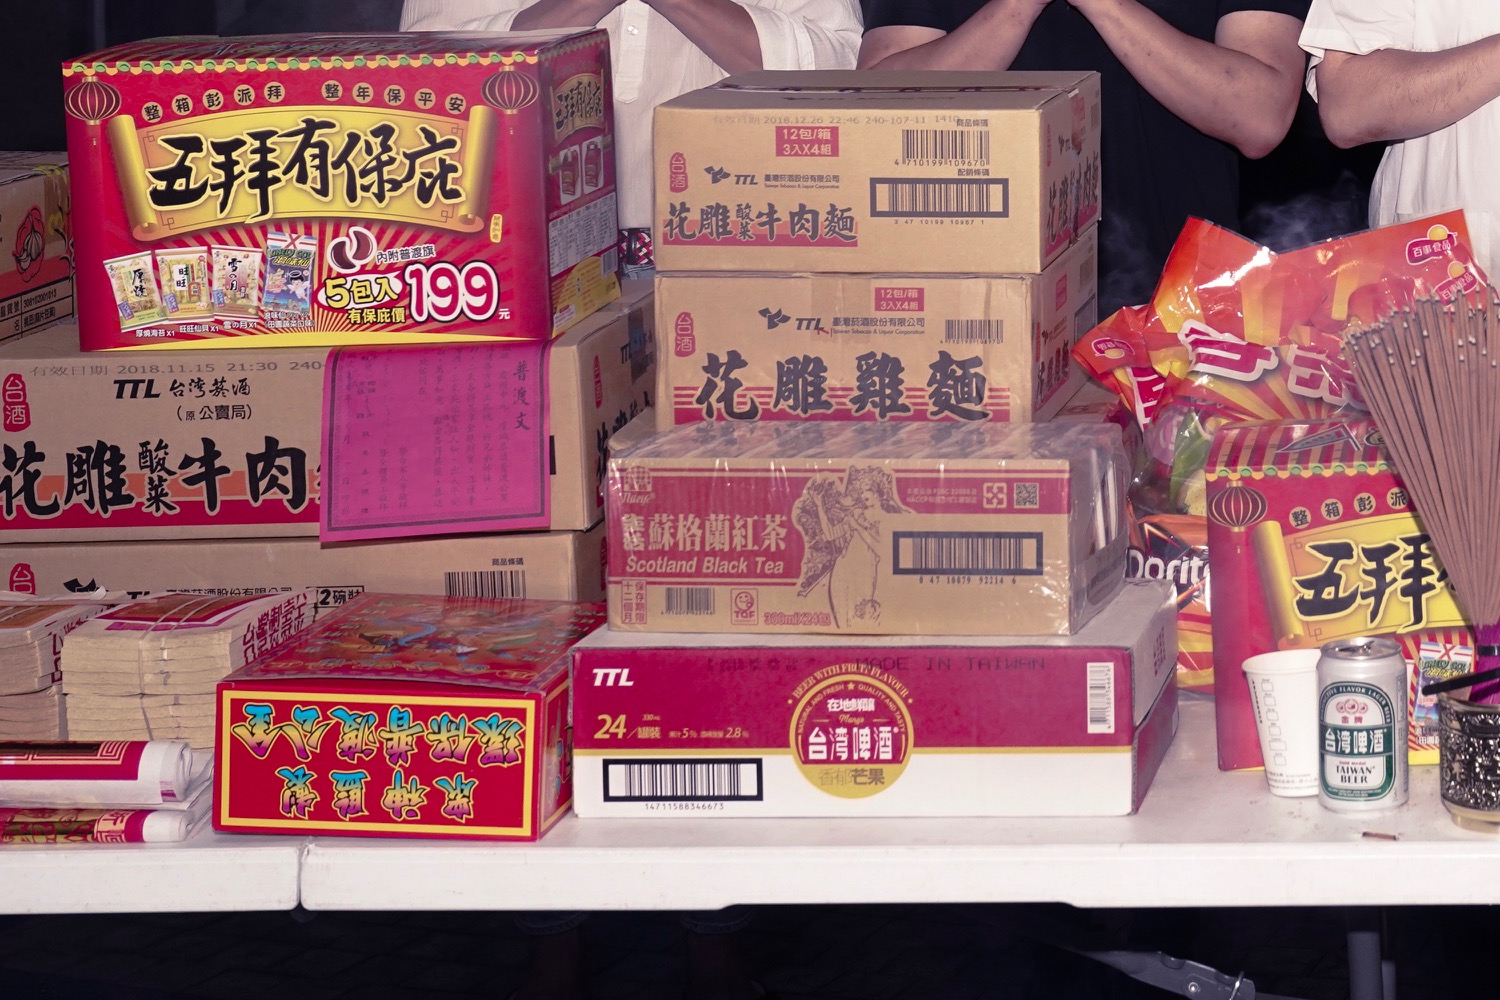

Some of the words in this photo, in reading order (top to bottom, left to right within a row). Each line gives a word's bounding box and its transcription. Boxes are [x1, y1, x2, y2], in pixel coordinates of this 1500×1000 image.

[145, 82, 285, 122] 整箱彭派拜
[323, 82, 467, 113] 整年保平安
[763, 115, 824, 125] 2018.12.26
[829, 116, 860, 125] 22:46
[865, 116, 926, 125] 240-107-11
[783, 128, 831, 140] 12包/箱
[783, 143, 832, 156] 3入X4組
[149, 118, 464, 222] 五拜有保庇
[671, 154, 686, 188] 台酒
[906, 159, 944, 167] 710199
[948, 159, 986, 167] 109670
[734, 174, 759, 185] TTL
[377, 244, 436, 264] 內附普渡旗
[324, 277, 400, 309] 5包入
[404, 261, 499, 323] 199
[498, 307, 511, 321] 元
[879, 289, 918, 299] 12包/箱
[348, 307, 406, 325] 有保庇價
[880, 300, 919, 311] 3入X4組
[676, 313, 693, 352] 台酒
[117, 363, 215, 375] 2018.11.15
[226, 361, 278, 372] 21:30
[113, 379, 161, 399] TTL
[513, 361, 530, 431] 普渡文
[696, 350, 991, 420] 花雕雞麵
[5, 376, 26, 425] 台酒
[0, 436, 320, 519] 花雕酸菜牛肉
[648, 513, 788, 553] 蘇格蘭紅茶
[626, 556, 697, 574] Scotland
[703, 556, 748, 574] Black
[755, 558, 784, 575] Tea
[1128, 548, 1210, 586] Dorit
[856, 656, 910, 671] MADE
[926, 656, 950, 671] IN
[966, 656, 1046, 671] TAIWAN
[592, 668, 635, 687] TTL
[792, 676, 816, 700] BEER
[814, 664, 841, 684] WITH
[871, 666, 910, 698] FLAVOUR
[232, 702, 529, 768] 環保普渡公金
[593, 714, 627, 739] 24
[1336, 765, 1373, 775] TAIWAN
[1340, 774, 1368, 784] BEER
[277, 766, 480, 822] 眾神監製
